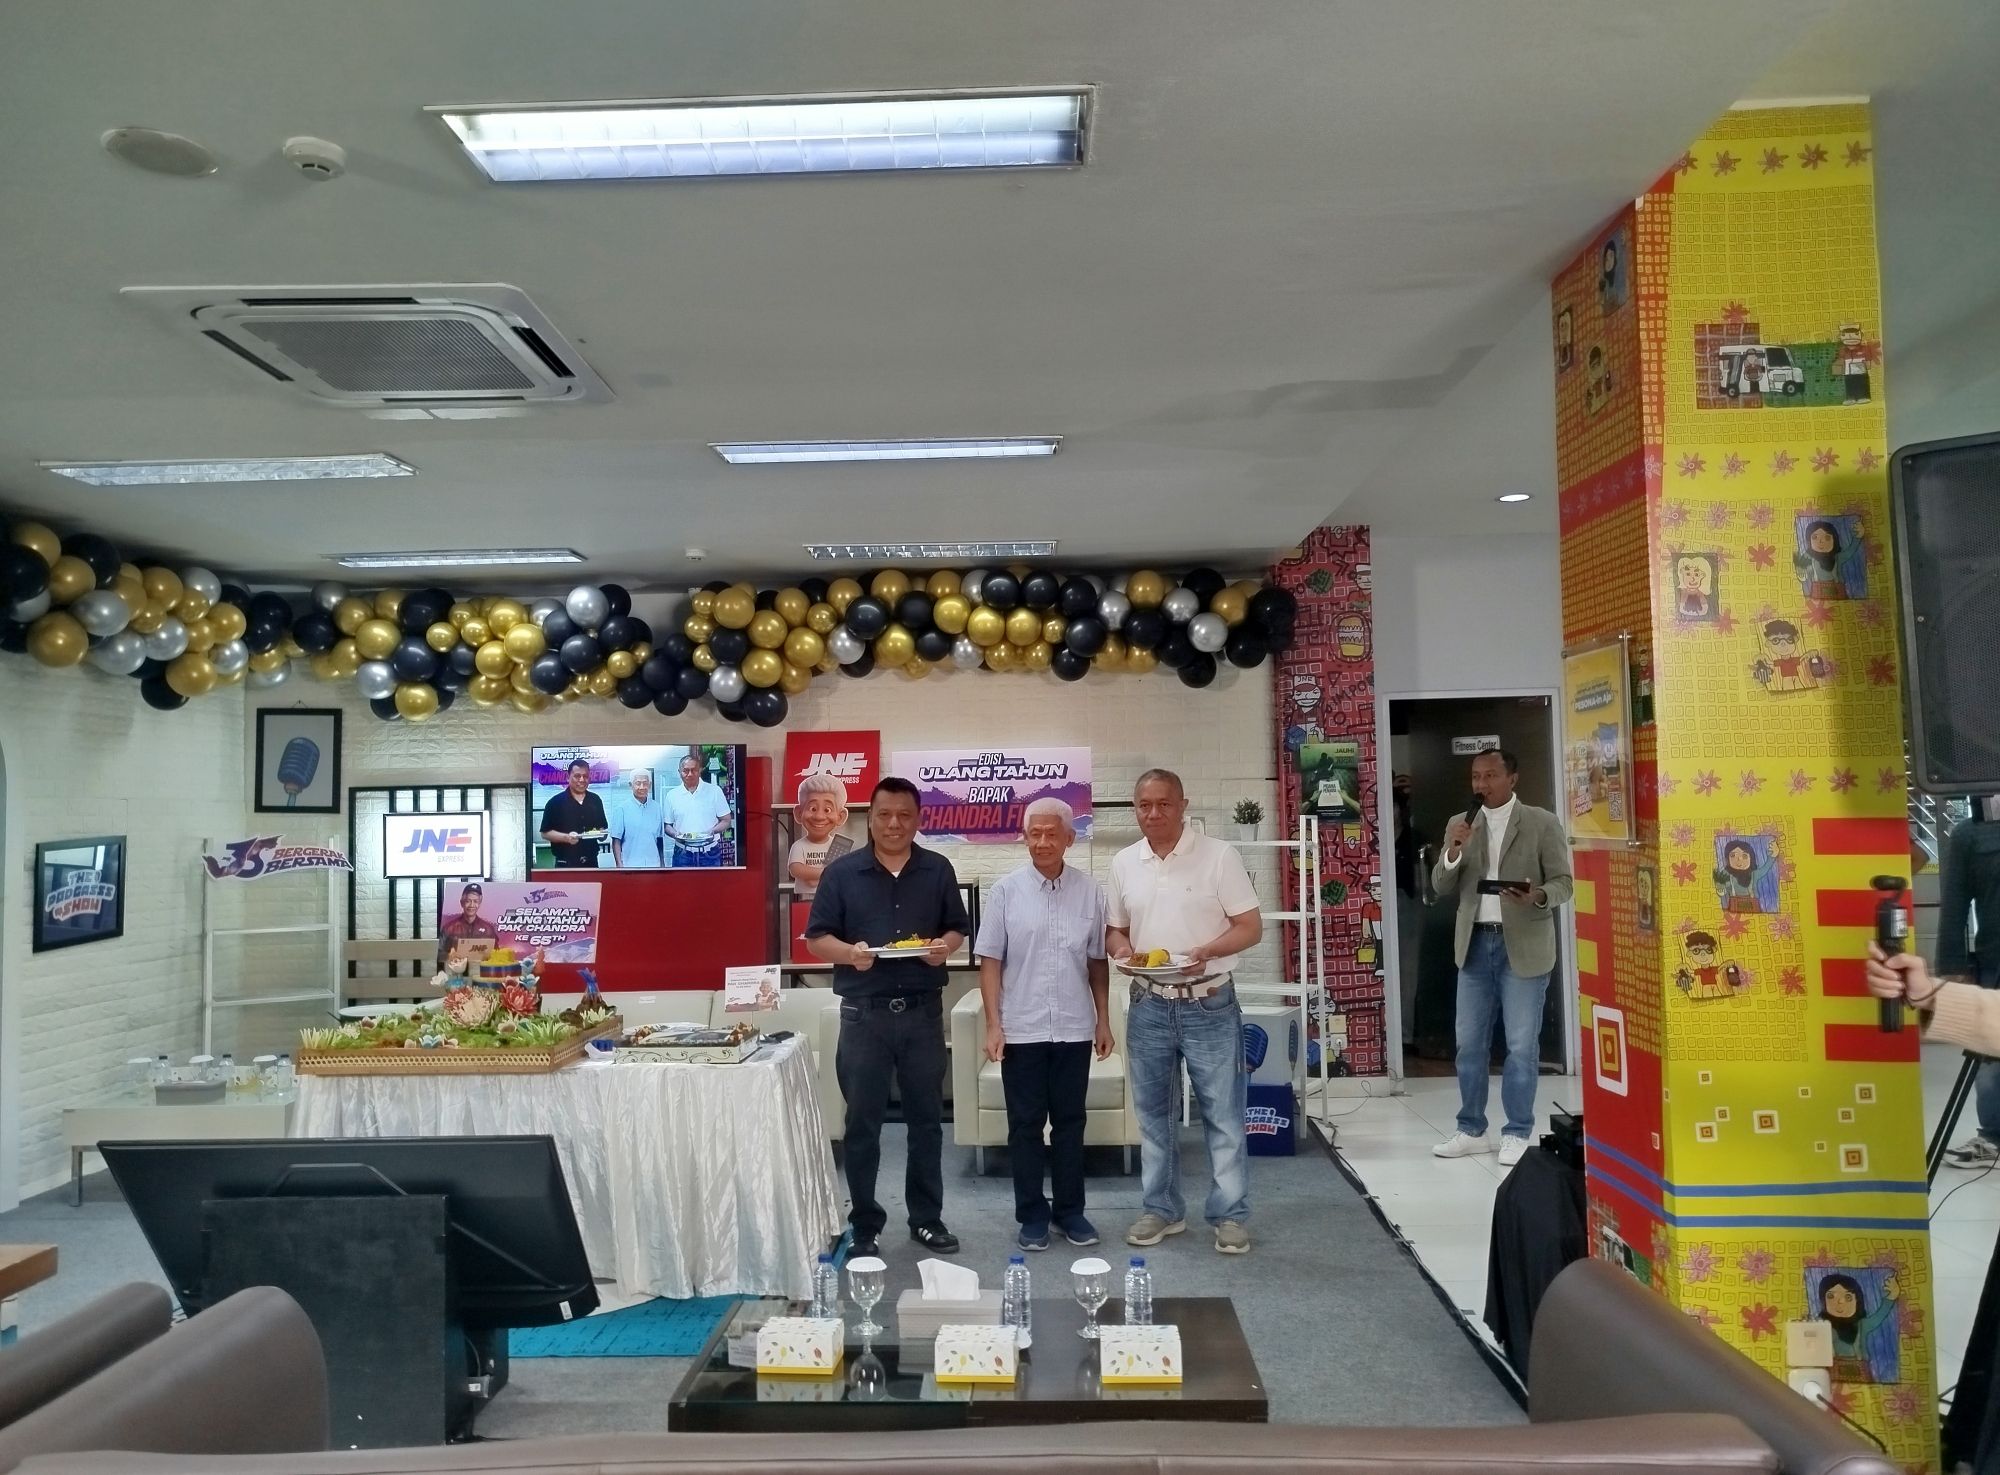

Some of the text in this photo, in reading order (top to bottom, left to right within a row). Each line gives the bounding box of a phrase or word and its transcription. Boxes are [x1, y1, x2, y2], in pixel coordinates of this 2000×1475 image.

[1455, 740, 1497, 751] Fitness Center
[795, 752, 868, 776] JNE
[979, 753, 1003, 766] EDISI
[919, 764, 1066, 780] ULANG TAHUN
[968, 786, 1011, 803] BAPAK
[920, 804, 1002, 830] CHANDRA
[403, 828, 472, 853] JNE
[272, 847, 345, 860] BERGERAK
[437, 855, 465, 863] EXPRESS
[262, 857, 353, 875] BERSAMA
[516, 907, 578, 916] SELAMAT
[498, 916, 591, 925] ULANG TAHUN
